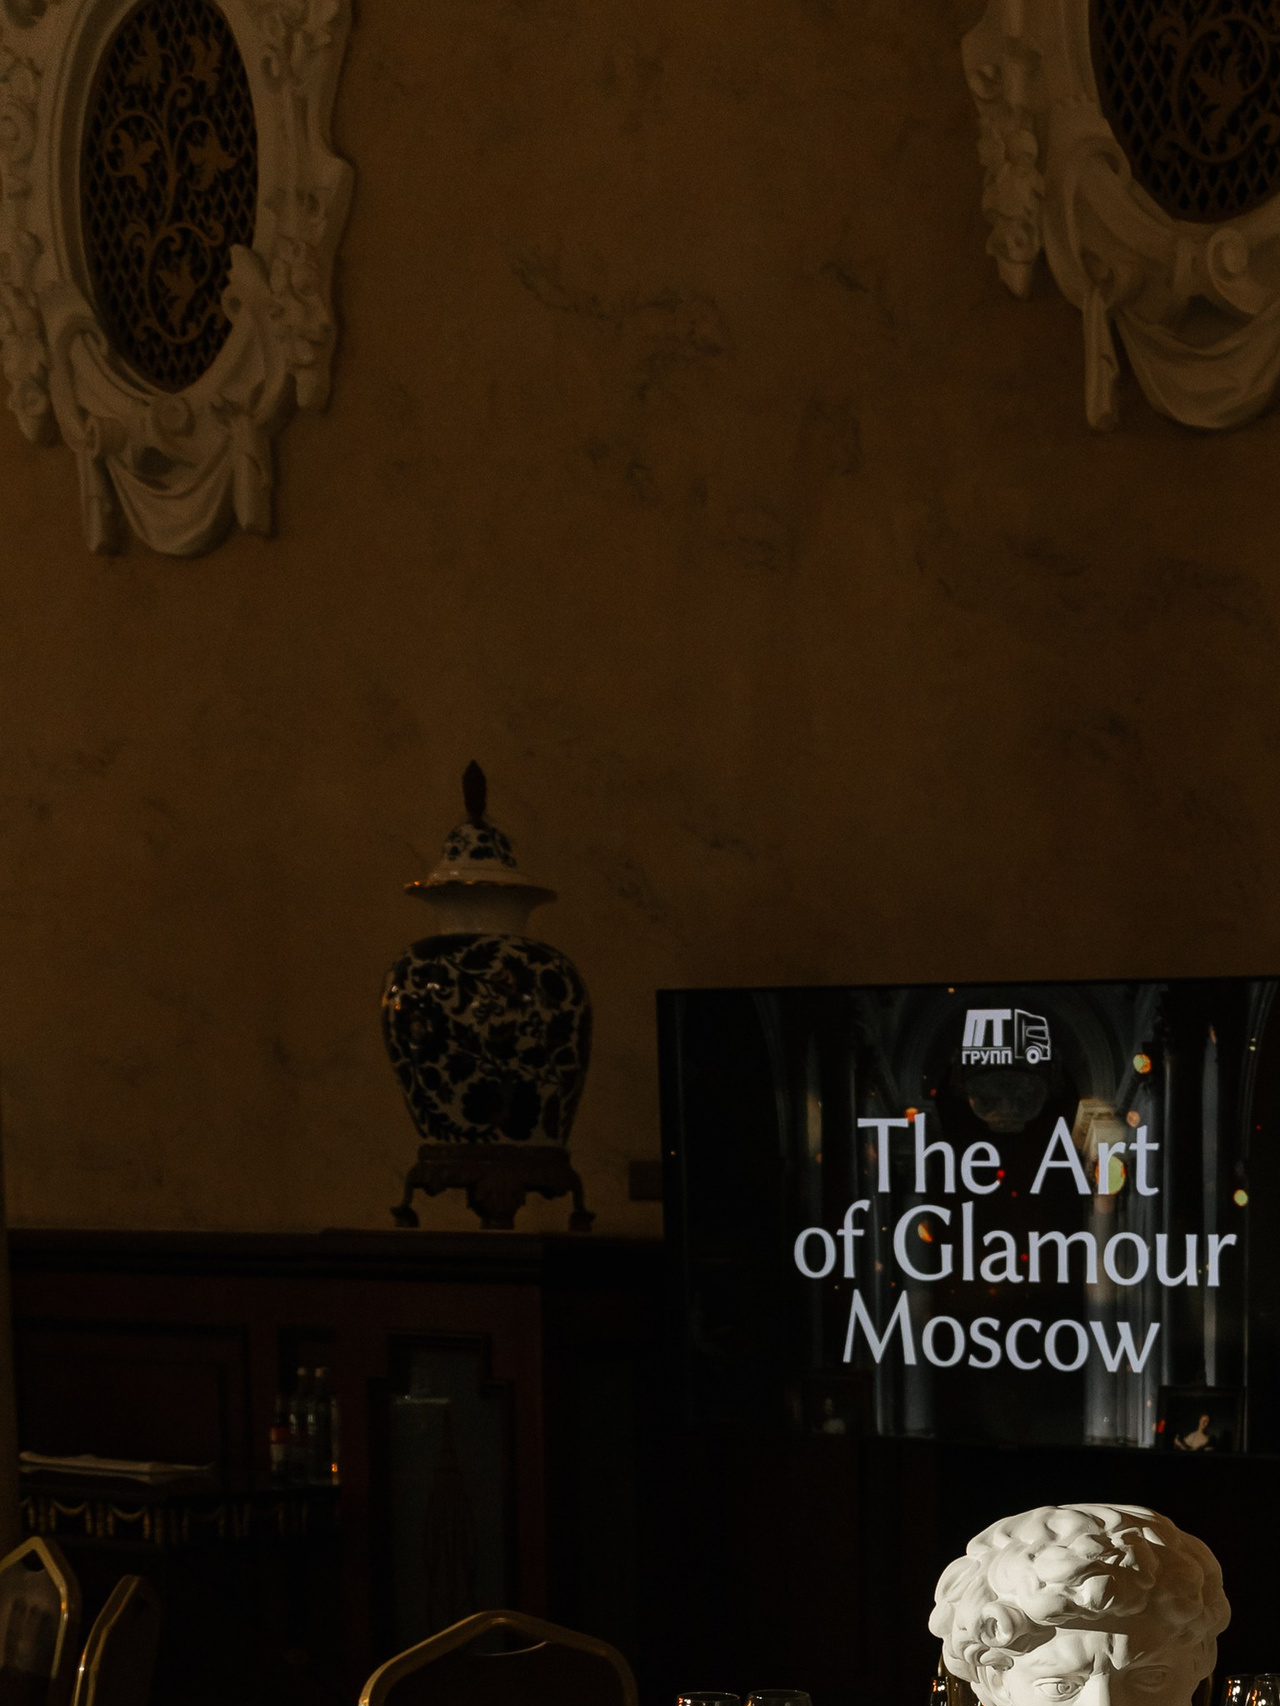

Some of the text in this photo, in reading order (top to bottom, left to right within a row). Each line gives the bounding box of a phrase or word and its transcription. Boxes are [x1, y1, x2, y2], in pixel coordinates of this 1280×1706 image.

[962, 1050, 1013, 1065] ГРУПП
[857, 1112, 1159, 1196] The Art
[793, 1199, 1237, 1287] of Glamour
[842, 1288, 1160, 1373] Moscow
